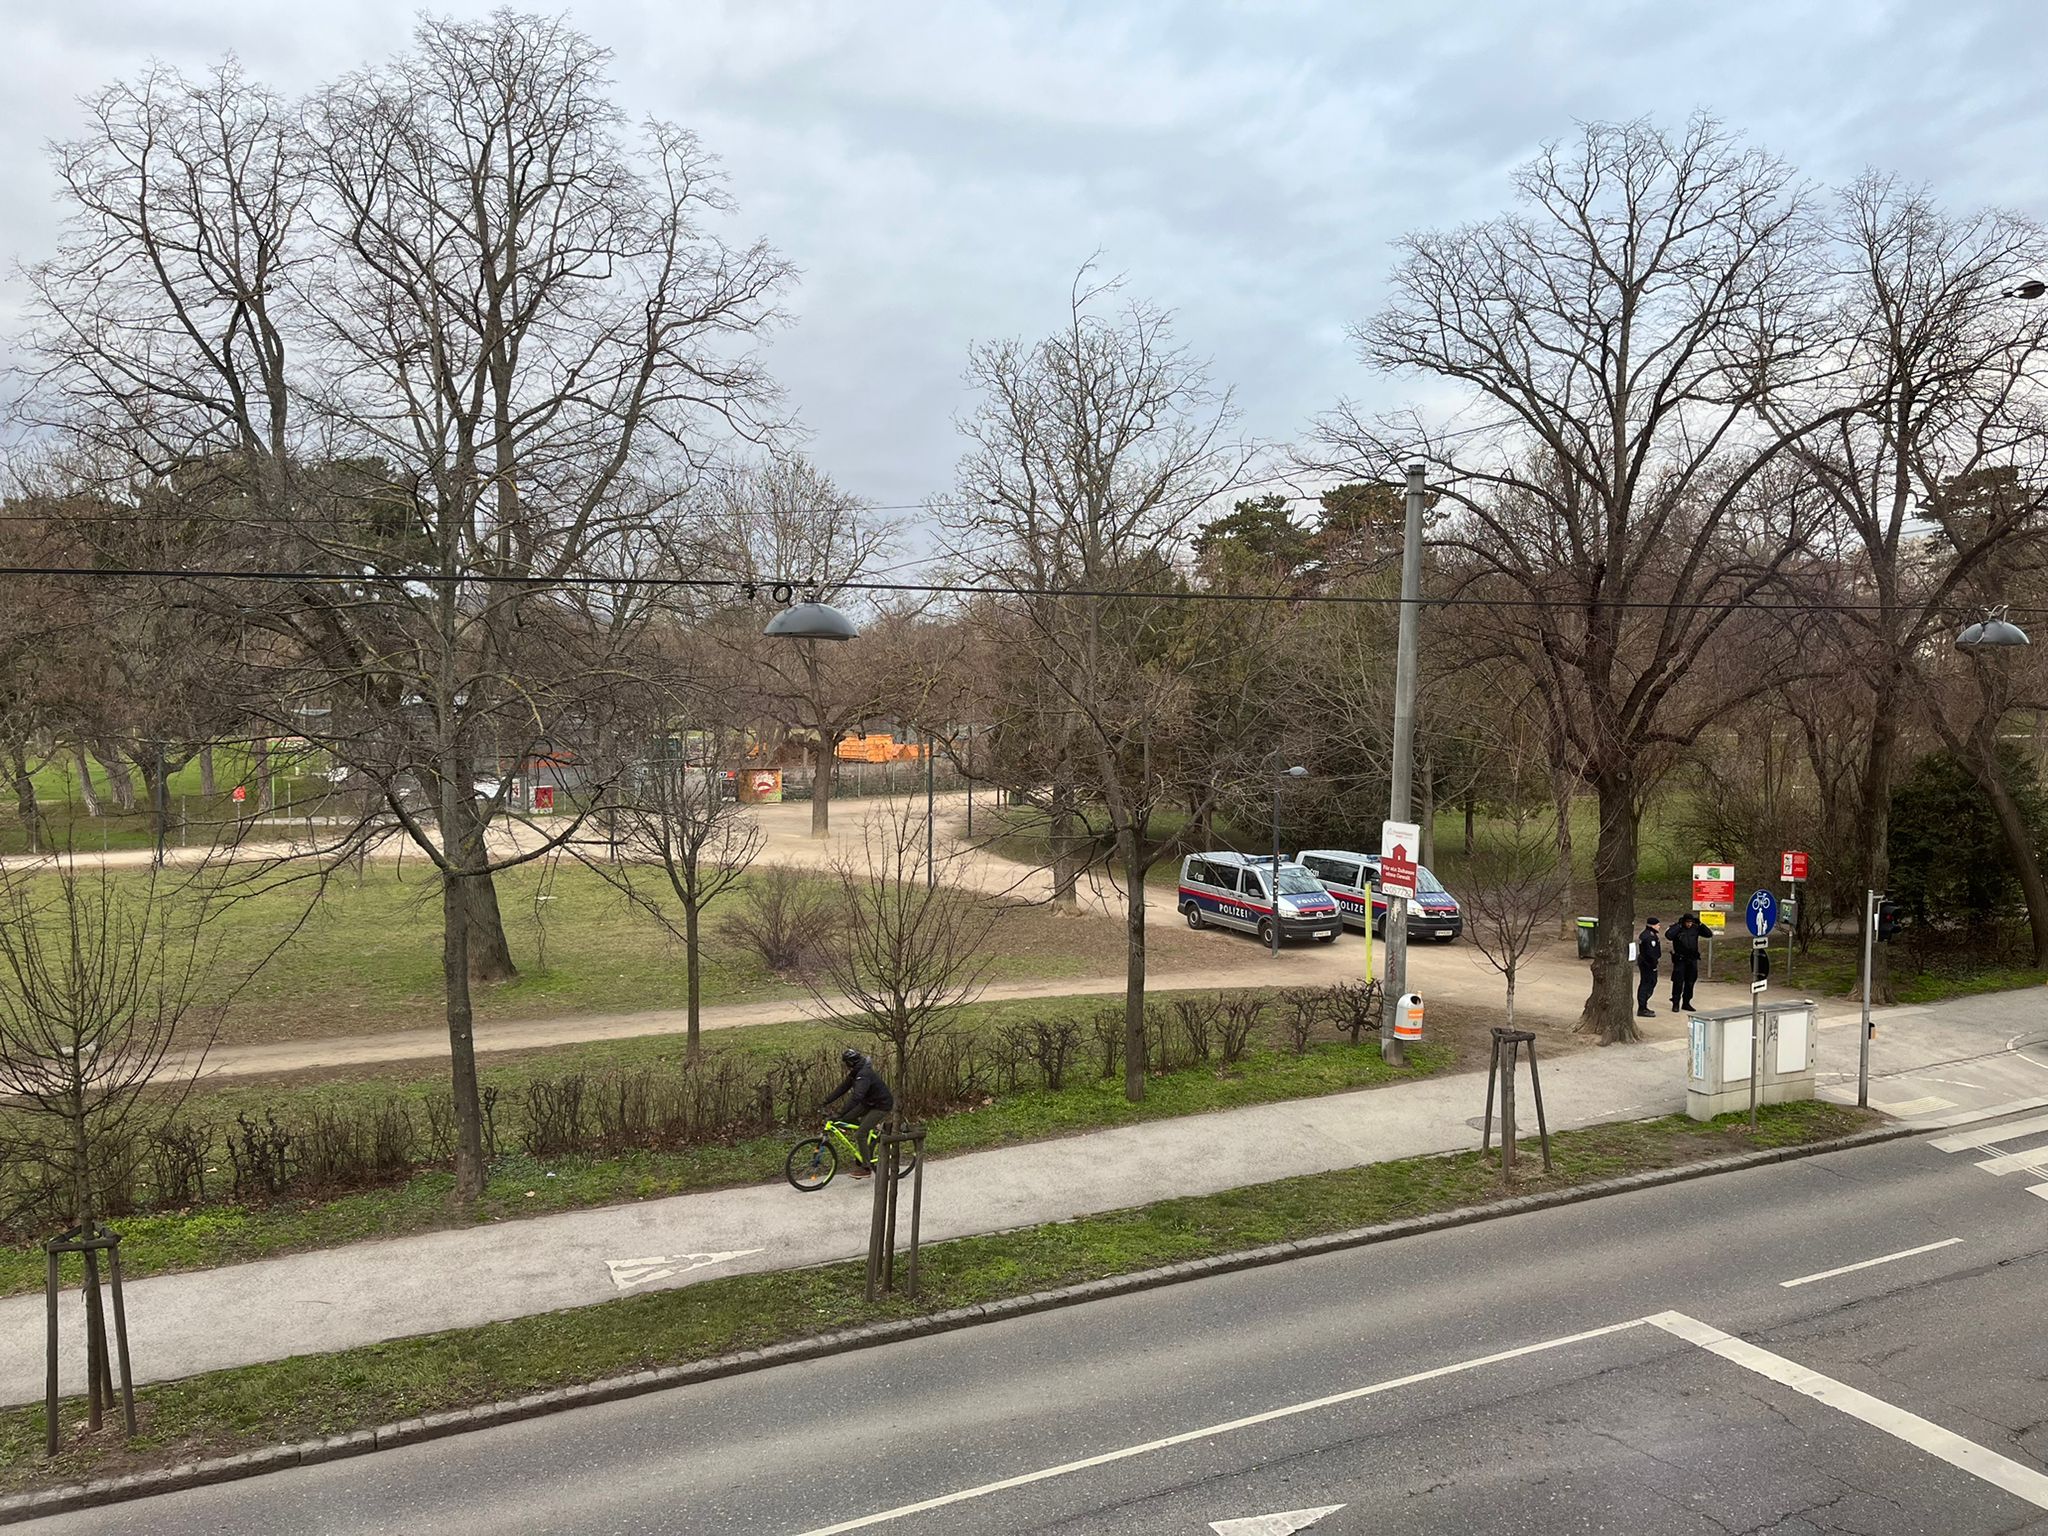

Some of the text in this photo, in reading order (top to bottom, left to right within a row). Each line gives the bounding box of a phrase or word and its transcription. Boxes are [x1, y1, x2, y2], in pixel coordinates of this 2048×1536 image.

[1397, 866, 1415, 876] Zuhause
[1218, 903, 1248, 918] POLIZEI
[1336, 899, 1365, 914] POLIZE
